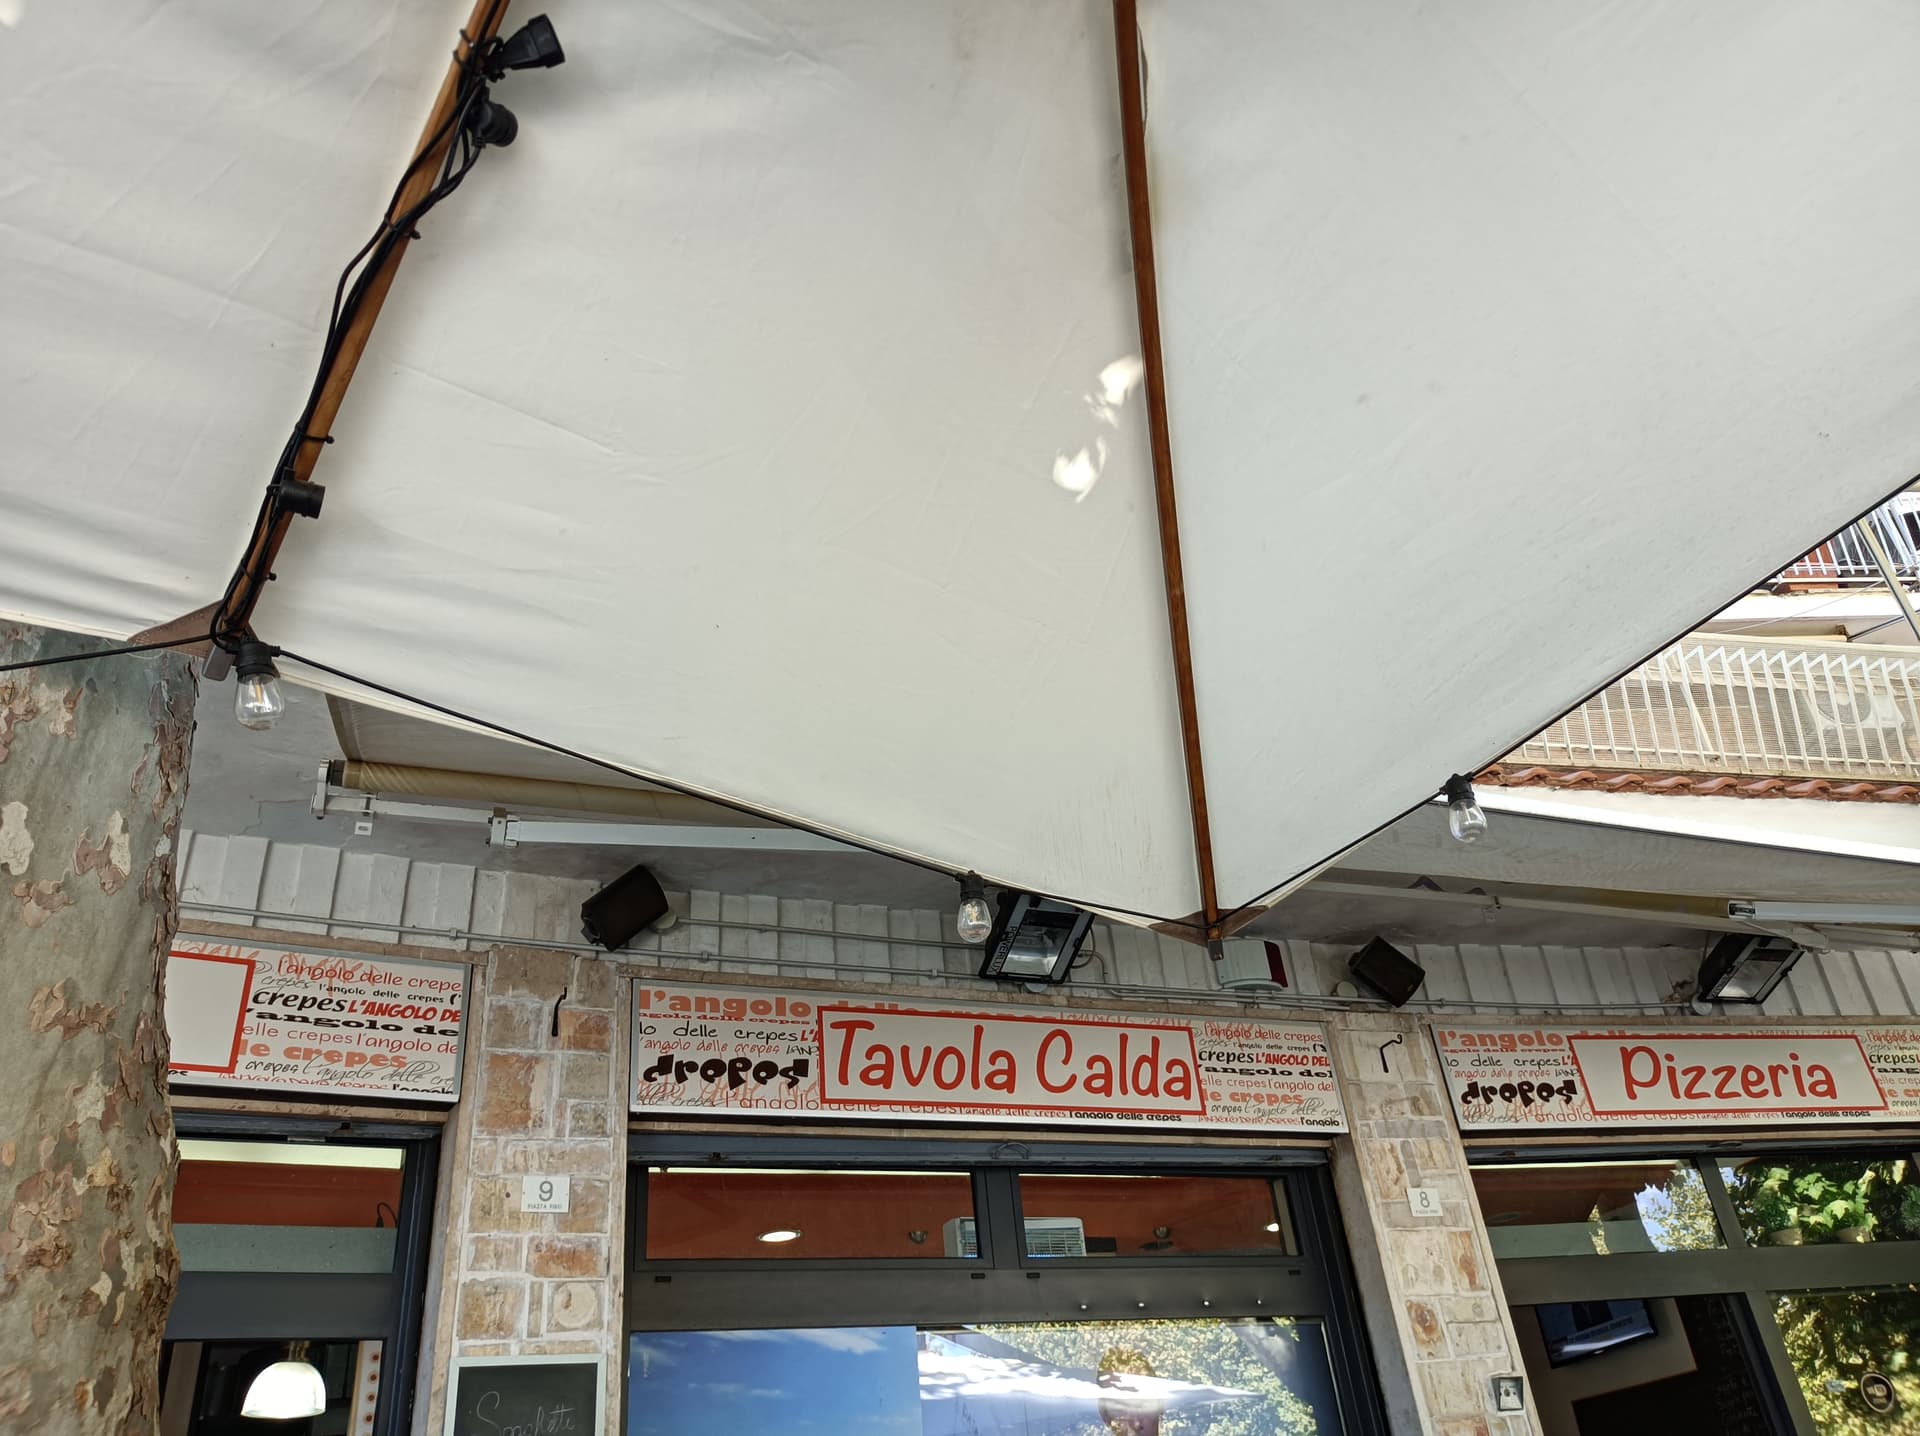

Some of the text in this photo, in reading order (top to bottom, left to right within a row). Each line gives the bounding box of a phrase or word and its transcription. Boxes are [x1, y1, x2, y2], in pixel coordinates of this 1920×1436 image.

[360, 964, 403, 986] delle
[372, 989, 401, 1000] delle
[639, 988, 812, 1019] l'angolo
[251, 990, 348, 1012] crepes
[347, 999, 438, 1022] L'ANGOLO
[242, 1022, 279, 1039] elle
[286, 1027, 353, 1046] crepes
[356, 1033, 432, 1053] l'angolo
[673, 1020, 718, 1039] delle
[734, 1028, 799, 1045] crepes
[1254, 1028, 1282, 1041] delle
[1283, 1032, 1323, 1044] crepes
[1437, 1030, 1564, 1049] l'angolo
[282, 1046, 408, 1069] crepes
[829, 1019, 1192, 1101] Tavola Calda
[1198, 1049, 1331, 1067] crepes L'ANGOLO DEL
[1470, 1053, 1503, 1067] delle
[1513, 1056, 1561, 1070] crepes
[1869, 1053, 1917, 1066] crepes
[1619, 1045, 1838, 1101] Pizzeria
[1226, 1077, 1266, 1091] crepes
[1268, 1078, 1315, 1093] l'angolo
[1229, 1090, 1305, 1107] crepes
[1116, 1112, 1144, 1121] delle
[538, 1180, 554, 1202] 9
[1419, 1191, 1431, 1208] 8
